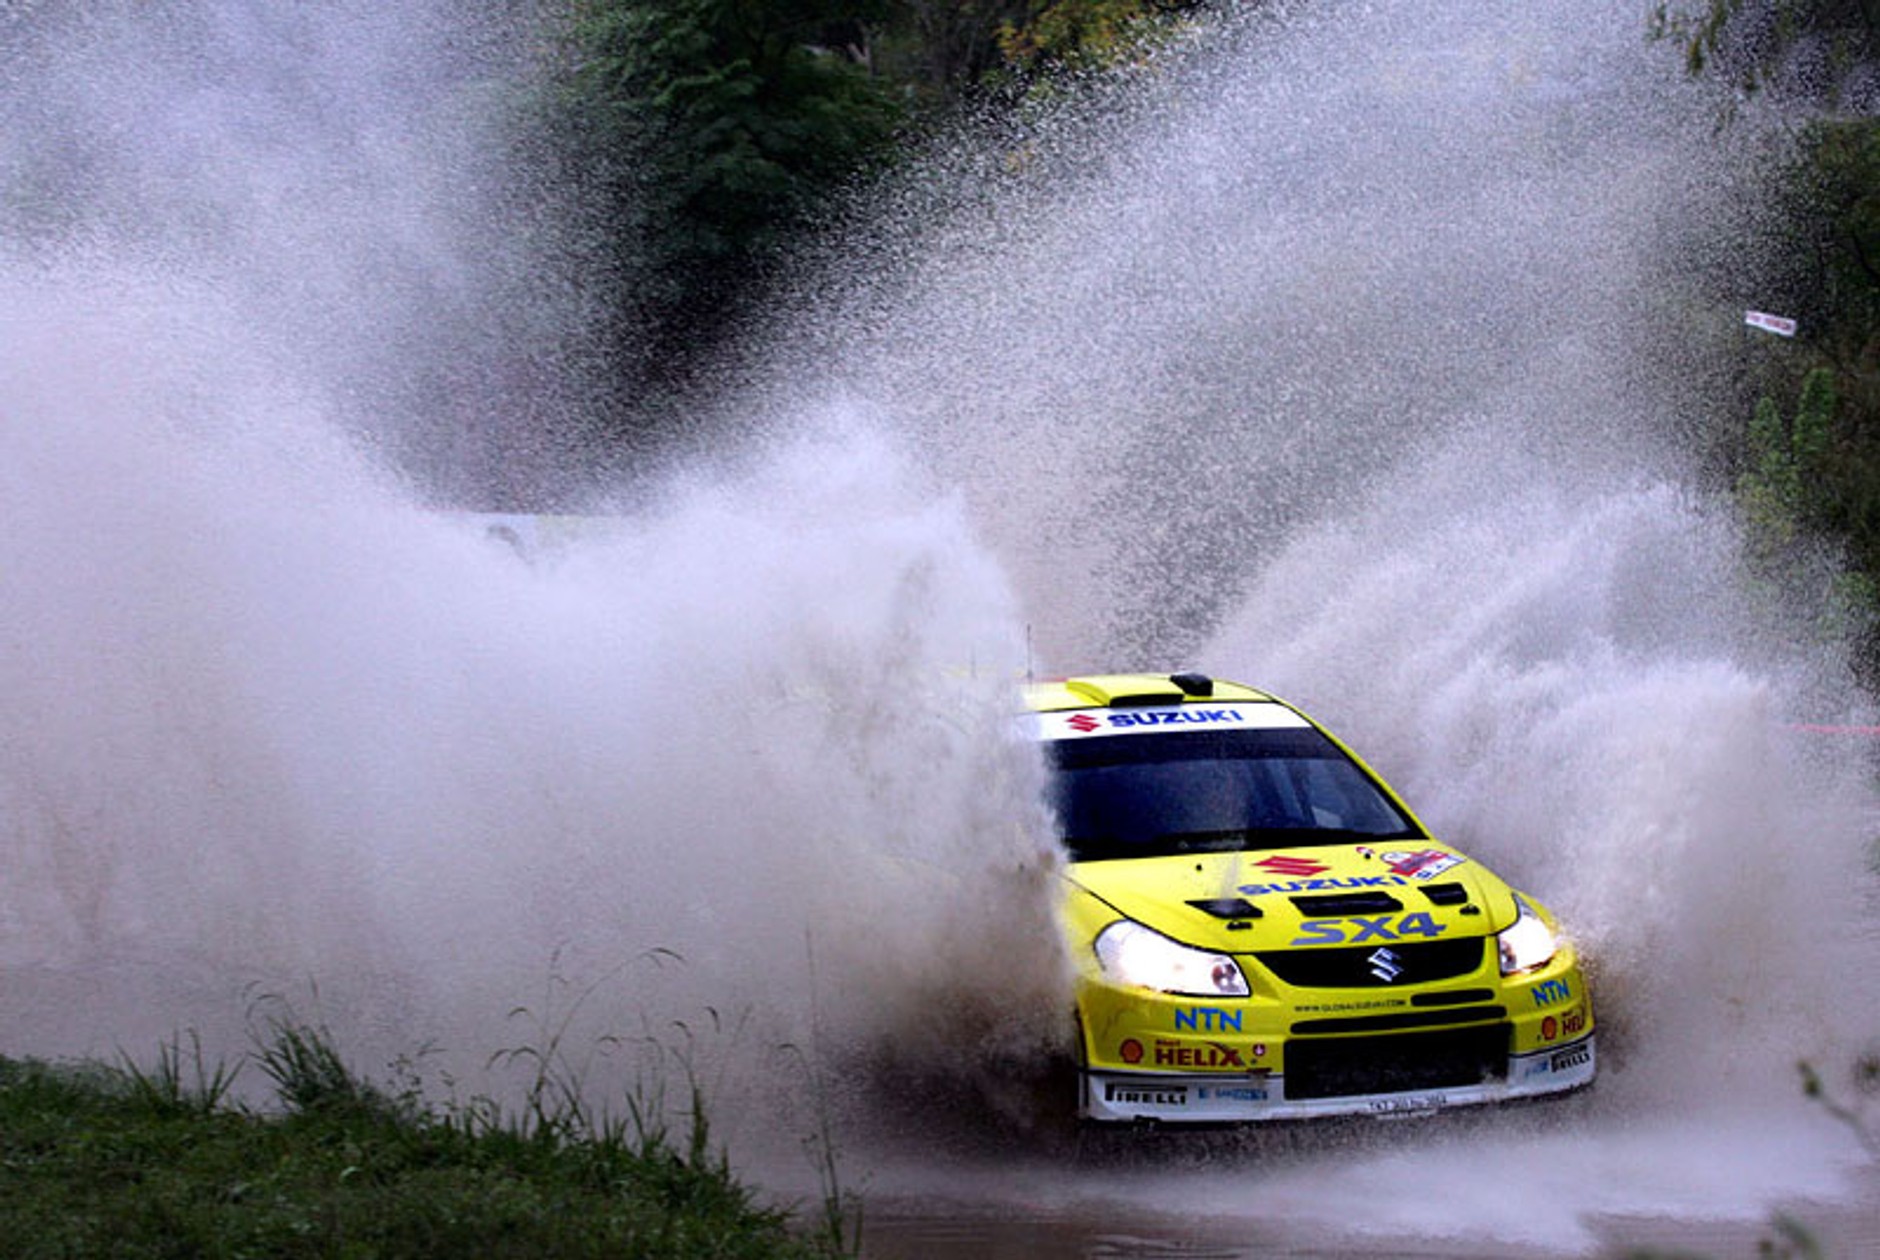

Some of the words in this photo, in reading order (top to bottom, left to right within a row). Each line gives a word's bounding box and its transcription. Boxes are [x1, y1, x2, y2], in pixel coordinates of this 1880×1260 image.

[1107, 710, 1244, 728] SUZUKI
[1236, 876, 1408, 895] SUZUKI
[1290, 912, 1447, 945] SX4
[1531, 978, 1570, 1007] NTN
[1174, 1008, 1242, 1032] NTN
[1155, 1041, 1246, 1067] HELIX
[1105, 1083, 1187, 1105] PIRELLI
